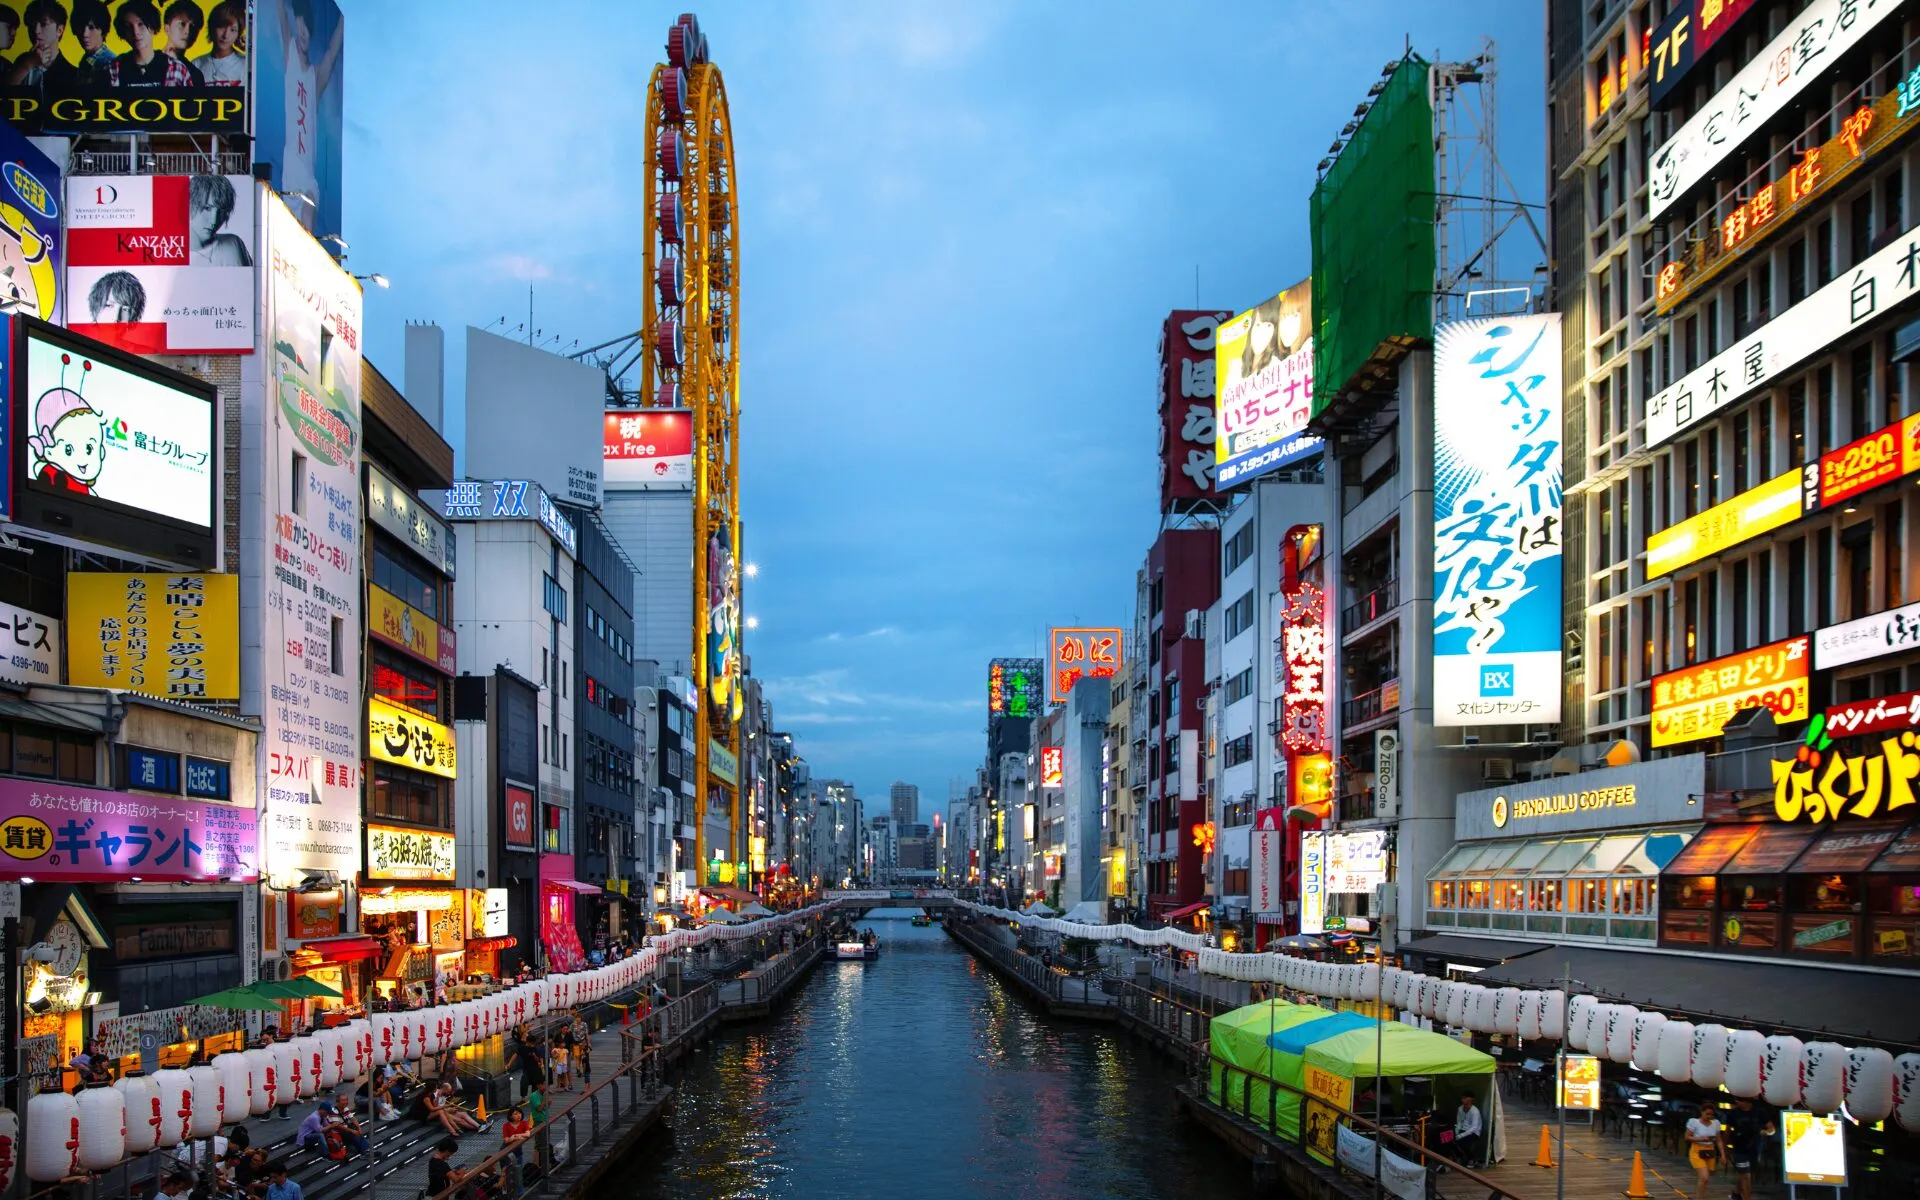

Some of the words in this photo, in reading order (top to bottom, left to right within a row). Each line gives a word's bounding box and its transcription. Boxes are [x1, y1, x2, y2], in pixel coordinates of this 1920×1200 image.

[1654, 15, 1689, 83] 7F
[51, 98, 243, 122] GROUP
[296, 79, 308, 154] ホスト
[117, 234, 185, 253] KANZAKI
[143, 245, 184, 263] RUKA
[163, 305, 237, 317] めっちゃ面白いを
[215, 319, 247, 329] 仕事に。
[1674, 340, 1767, 428] 白木屋
[299, 387, 351, 449] 新規会員募集
[1651, 393, 1668, 417] 4F
[299, 420, 320, 449] 入会金
[620, 417, 642, 439] 税
[134, 430, 209, 466] 富士グループ
[624, 442, 656, 456] Free
[1803, 463, 1819, 511] 3F
[127, 578, 147, 686] あなたのお店づくり
[166, 577, 207, 697] 素晴らしい夢の実現
[100, 618, 122, 678] 応援します
[1059, 636, 1115, 663] かに
[11, 655, 49, 674] 4396-7000
[1280, 581, 1325, 751] 大阪王将
[1653, 649, 1787, 708] 豊後高田どり
[1786, 639, 1808, 661] 2F
[323, 684, 349, 704] 3,780円
[1484, 672, 1511, 689] BX
[1675, 699, 1731, 736] 酒場
[384, 714, 437, 766] うなぎ
[142, 756, 156, 785] 酒
[187, 764, 217, 792] たばこ
[270, 752, 310, 781] コスパ
[1380, 753, 1391, 785] ZERO
[1380, 785, 1388, 809] cafe
[1513, 792, 1577, 818] HONOLULU
[1580, 785, 1636, 810] COFFEE
[205, 818, 255, 830] 06-6212-3013
[512, 800, 526, 832] G3
[4, 825, 46, 850] 賃貸
[55, 817, 203, 867] ギャラント
[389, 833, 433, 866] お好み焼
[50, 853, 61, 866] の
[1345, 875, 1367, 890] 免税
[139, 925, 218, 952] FamilyMart
